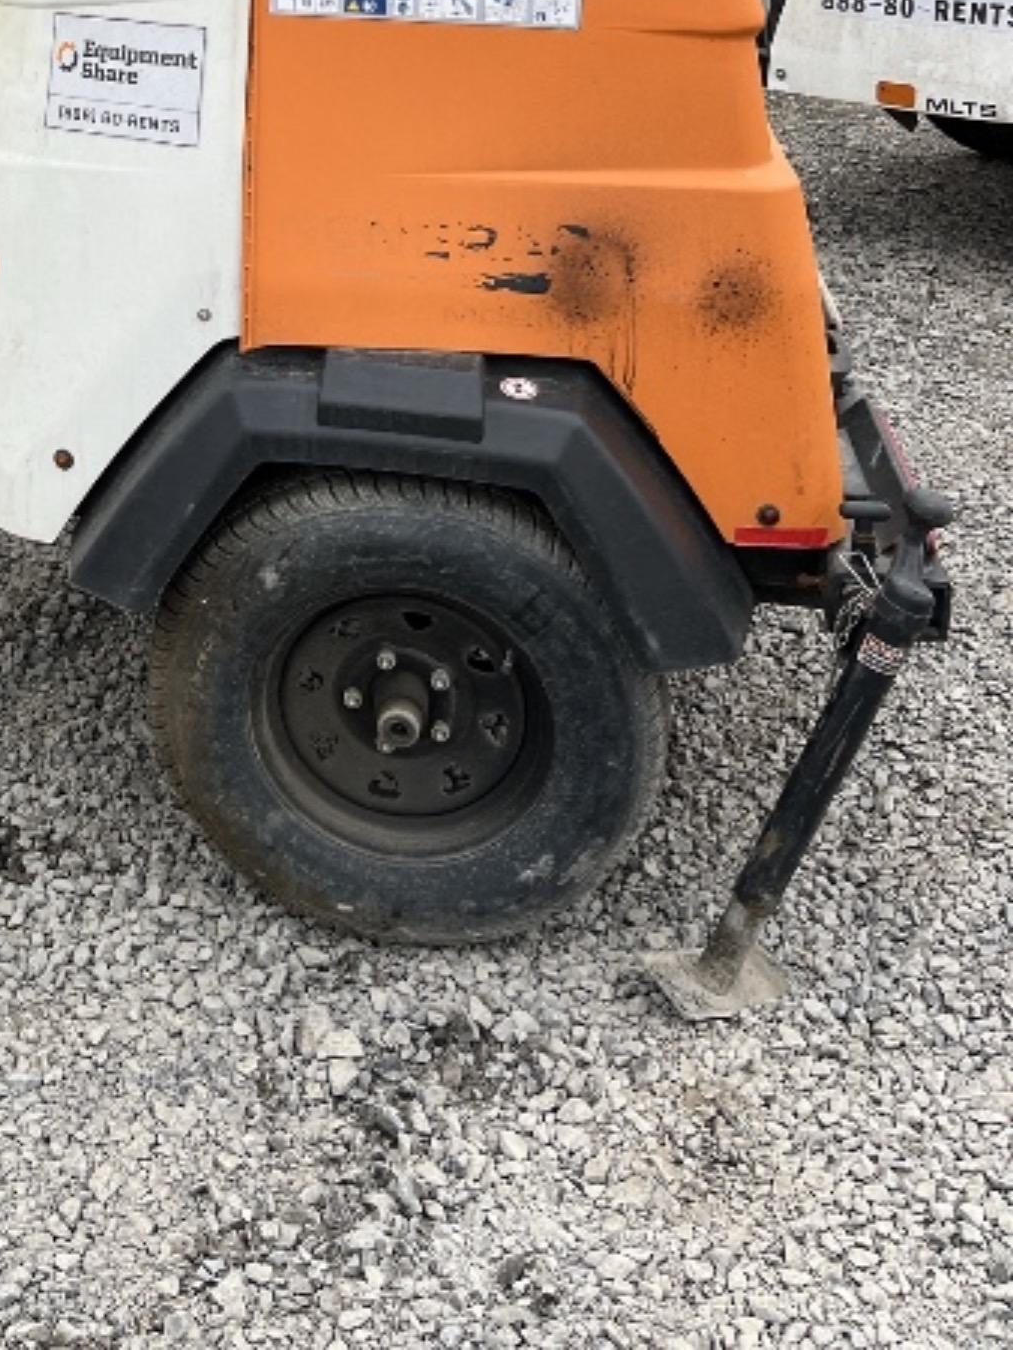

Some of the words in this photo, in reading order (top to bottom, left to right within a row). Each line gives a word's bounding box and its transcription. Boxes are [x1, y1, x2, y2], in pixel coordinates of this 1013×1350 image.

[82, 38, 199, 70] Equipment
[81, 61, 139, 85] Share
[925, 97, 997, 118] MLTS
